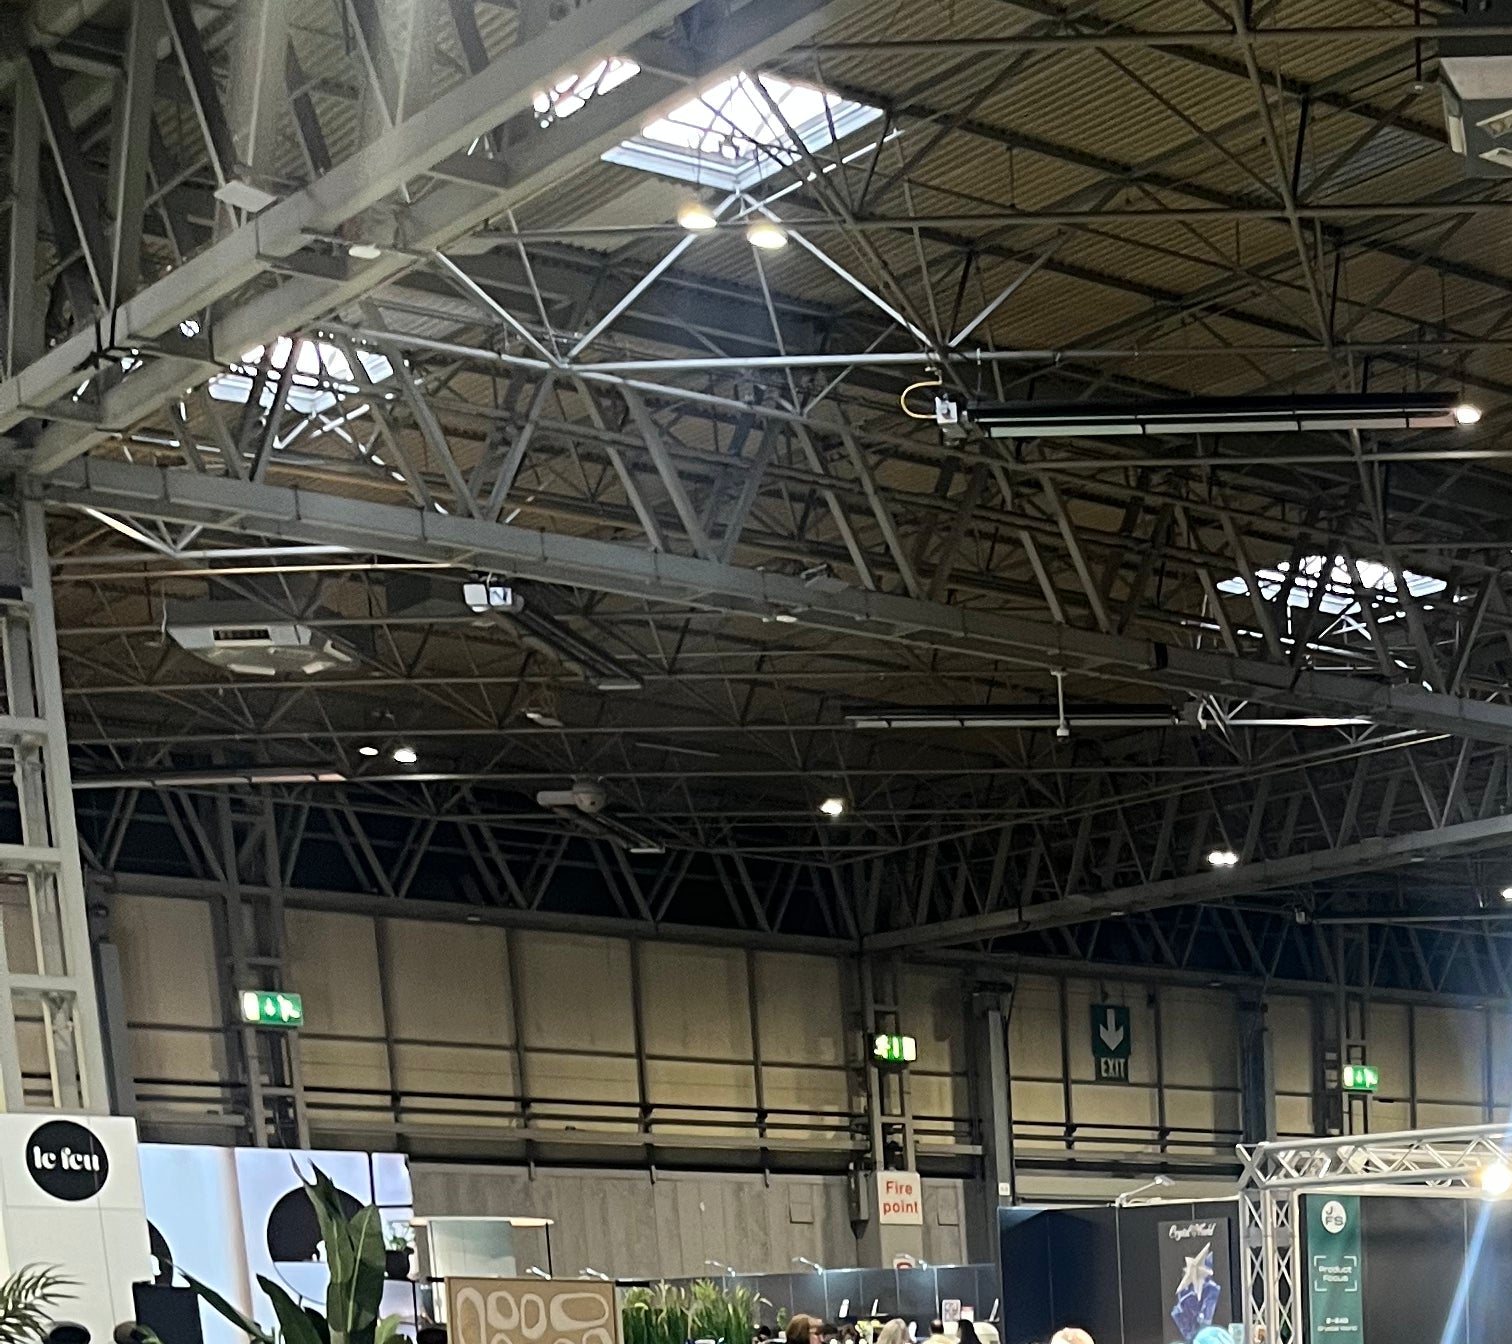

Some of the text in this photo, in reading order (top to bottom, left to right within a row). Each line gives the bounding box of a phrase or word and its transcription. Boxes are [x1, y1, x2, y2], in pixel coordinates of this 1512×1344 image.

[1100, 1057, 1126, 1078] EXIT
[33, 1145, 100, 1171] le feu
[885, 1181, 913, 1195] Fire
[882, 1200, 918, 1215] point
[1325, 1206, 1333, 1215] J
[1325, 1216, 1344, 1226] FS
